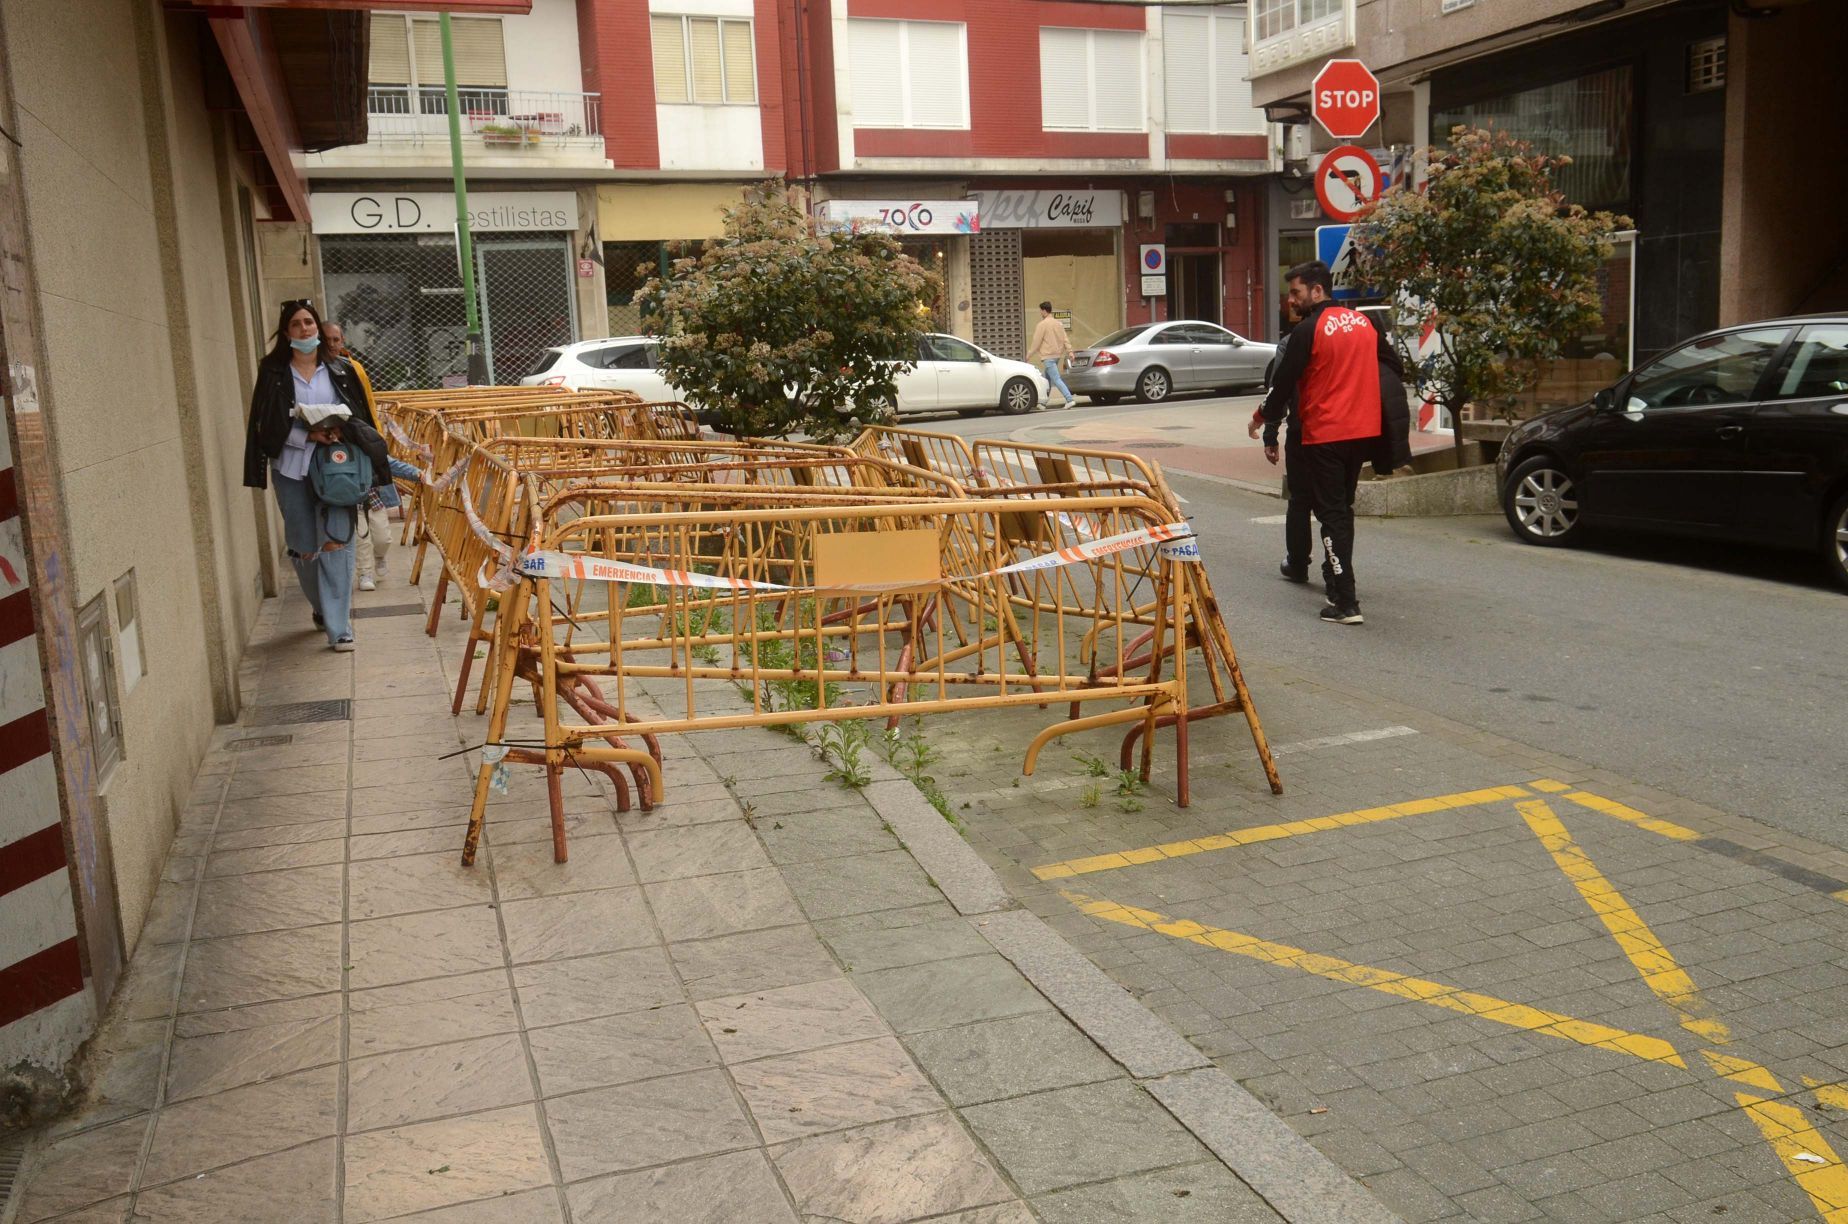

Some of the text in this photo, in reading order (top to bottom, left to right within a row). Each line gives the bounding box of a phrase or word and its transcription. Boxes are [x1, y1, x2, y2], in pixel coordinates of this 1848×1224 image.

[1320, 90, 1374, 108] STOP
[351, 197, 567, 228] G.D. estilistas
[592, 564, 658, 583] EMERXENCIAS
